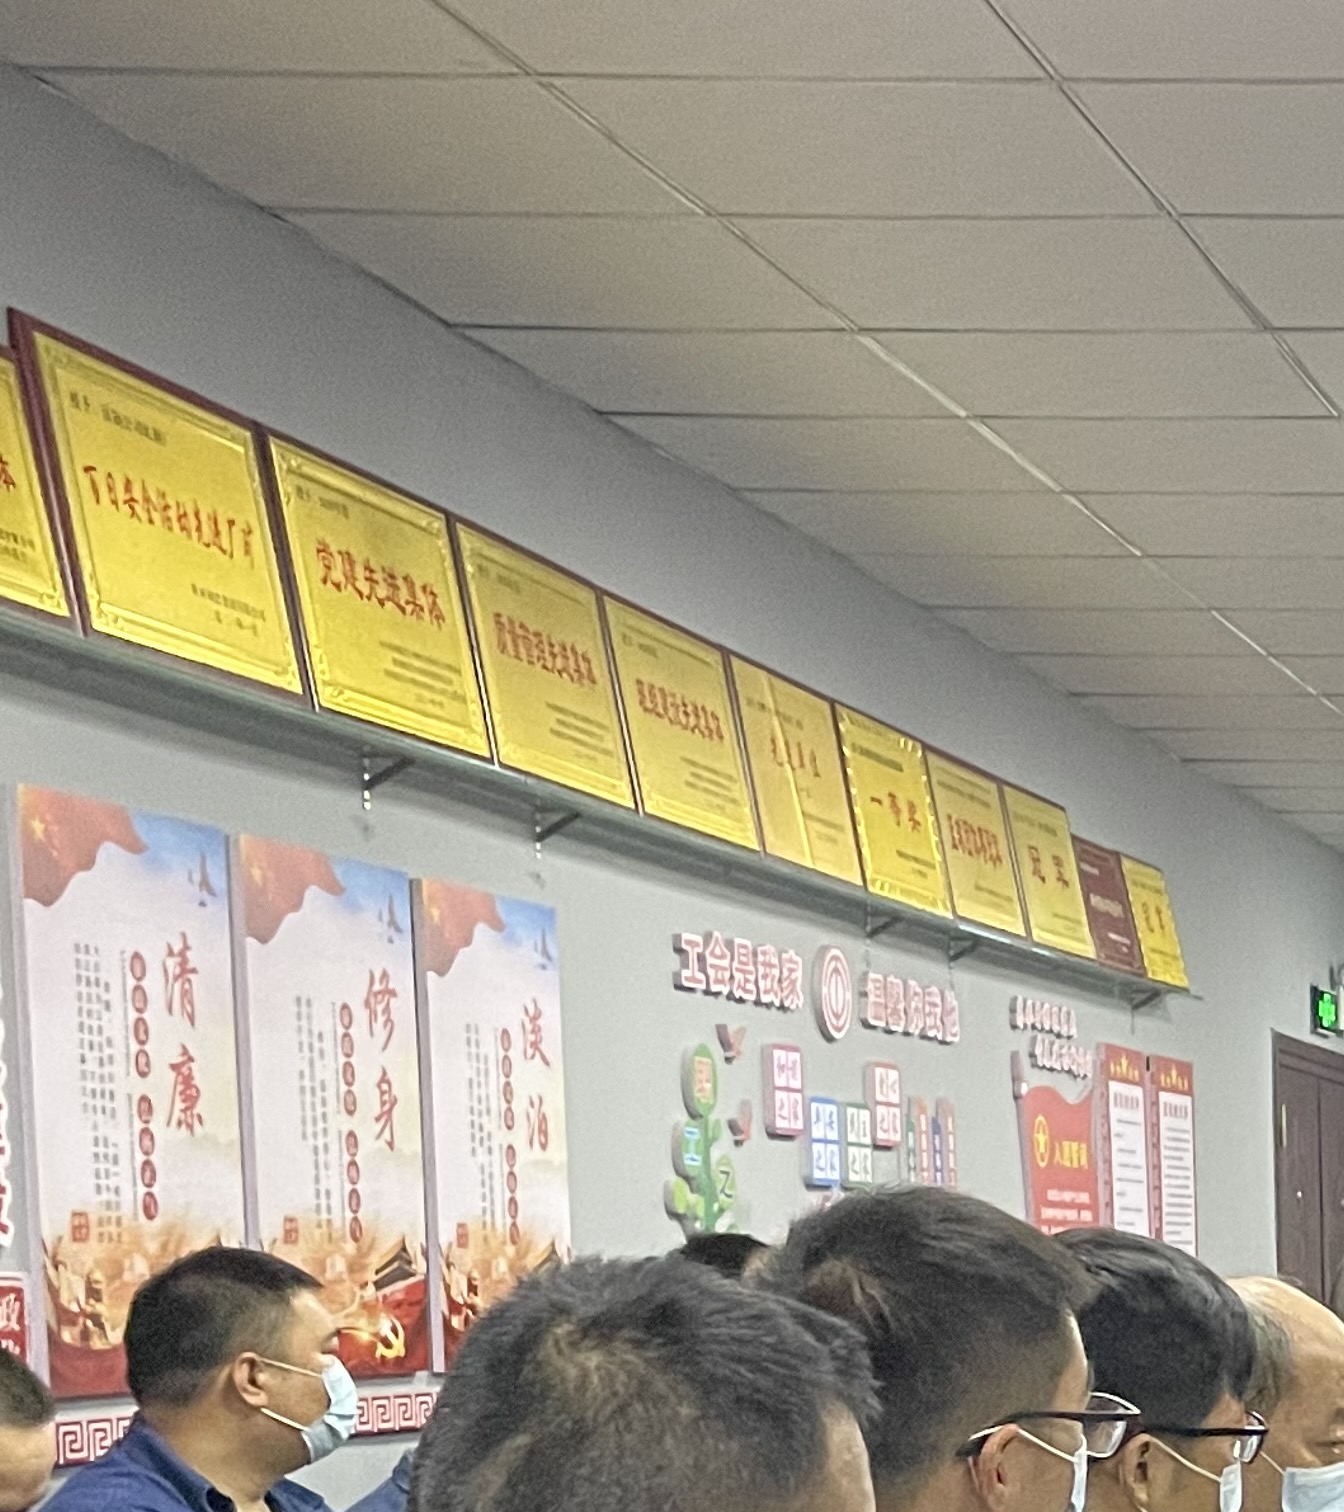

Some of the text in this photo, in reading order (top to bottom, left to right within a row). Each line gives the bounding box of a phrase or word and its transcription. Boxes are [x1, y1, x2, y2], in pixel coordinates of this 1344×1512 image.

[316, 537, 446, 630] 党建先进集体
[163, 931, 204, 1137] 清廉
[681, 930, 804, 1010] 工会是我家
[363, 967, 398, 1152] 修身
[521, 997, 551, 1152] 淡泊
